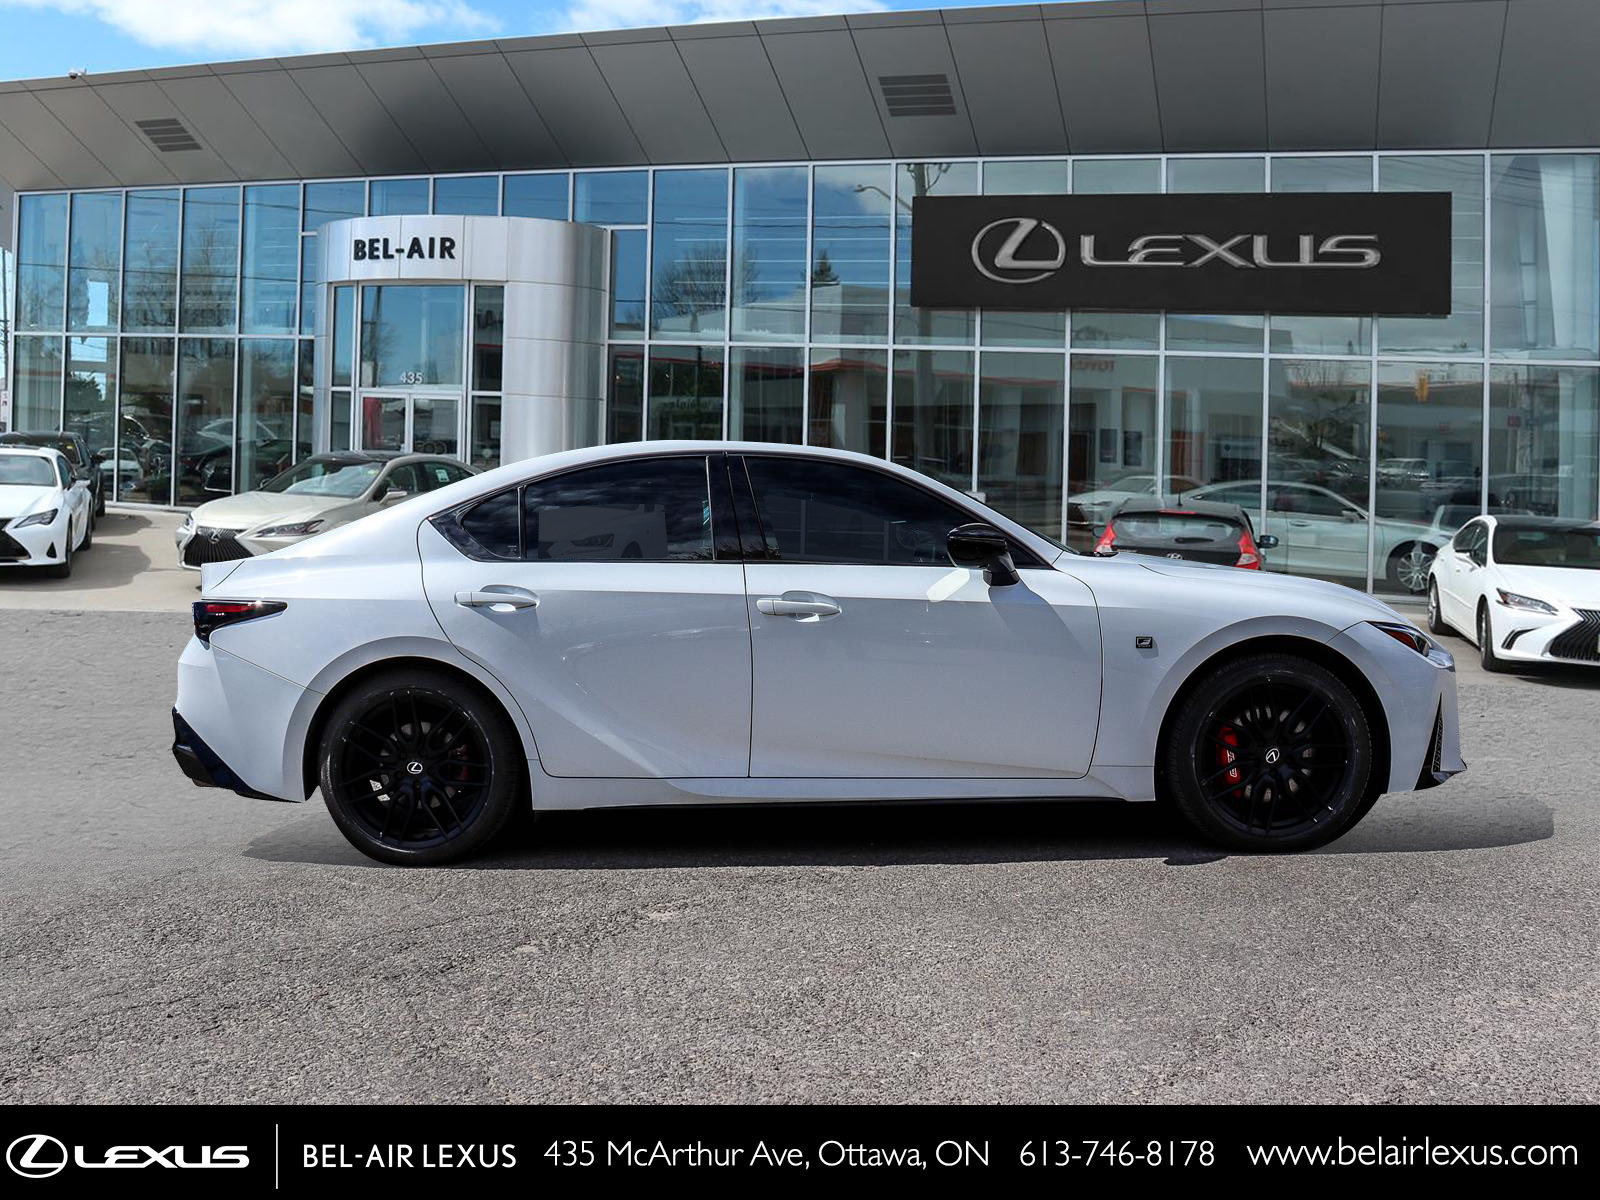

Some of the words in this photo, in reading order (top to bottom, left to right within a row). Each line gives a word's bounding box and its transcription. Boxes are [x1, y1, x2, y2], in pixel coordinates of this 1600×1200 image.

[353, 237, 456, 261] BEL-AIR
[1080, 234, 1381, 268] LEXUS
[400, 371, 423, 384] 435
